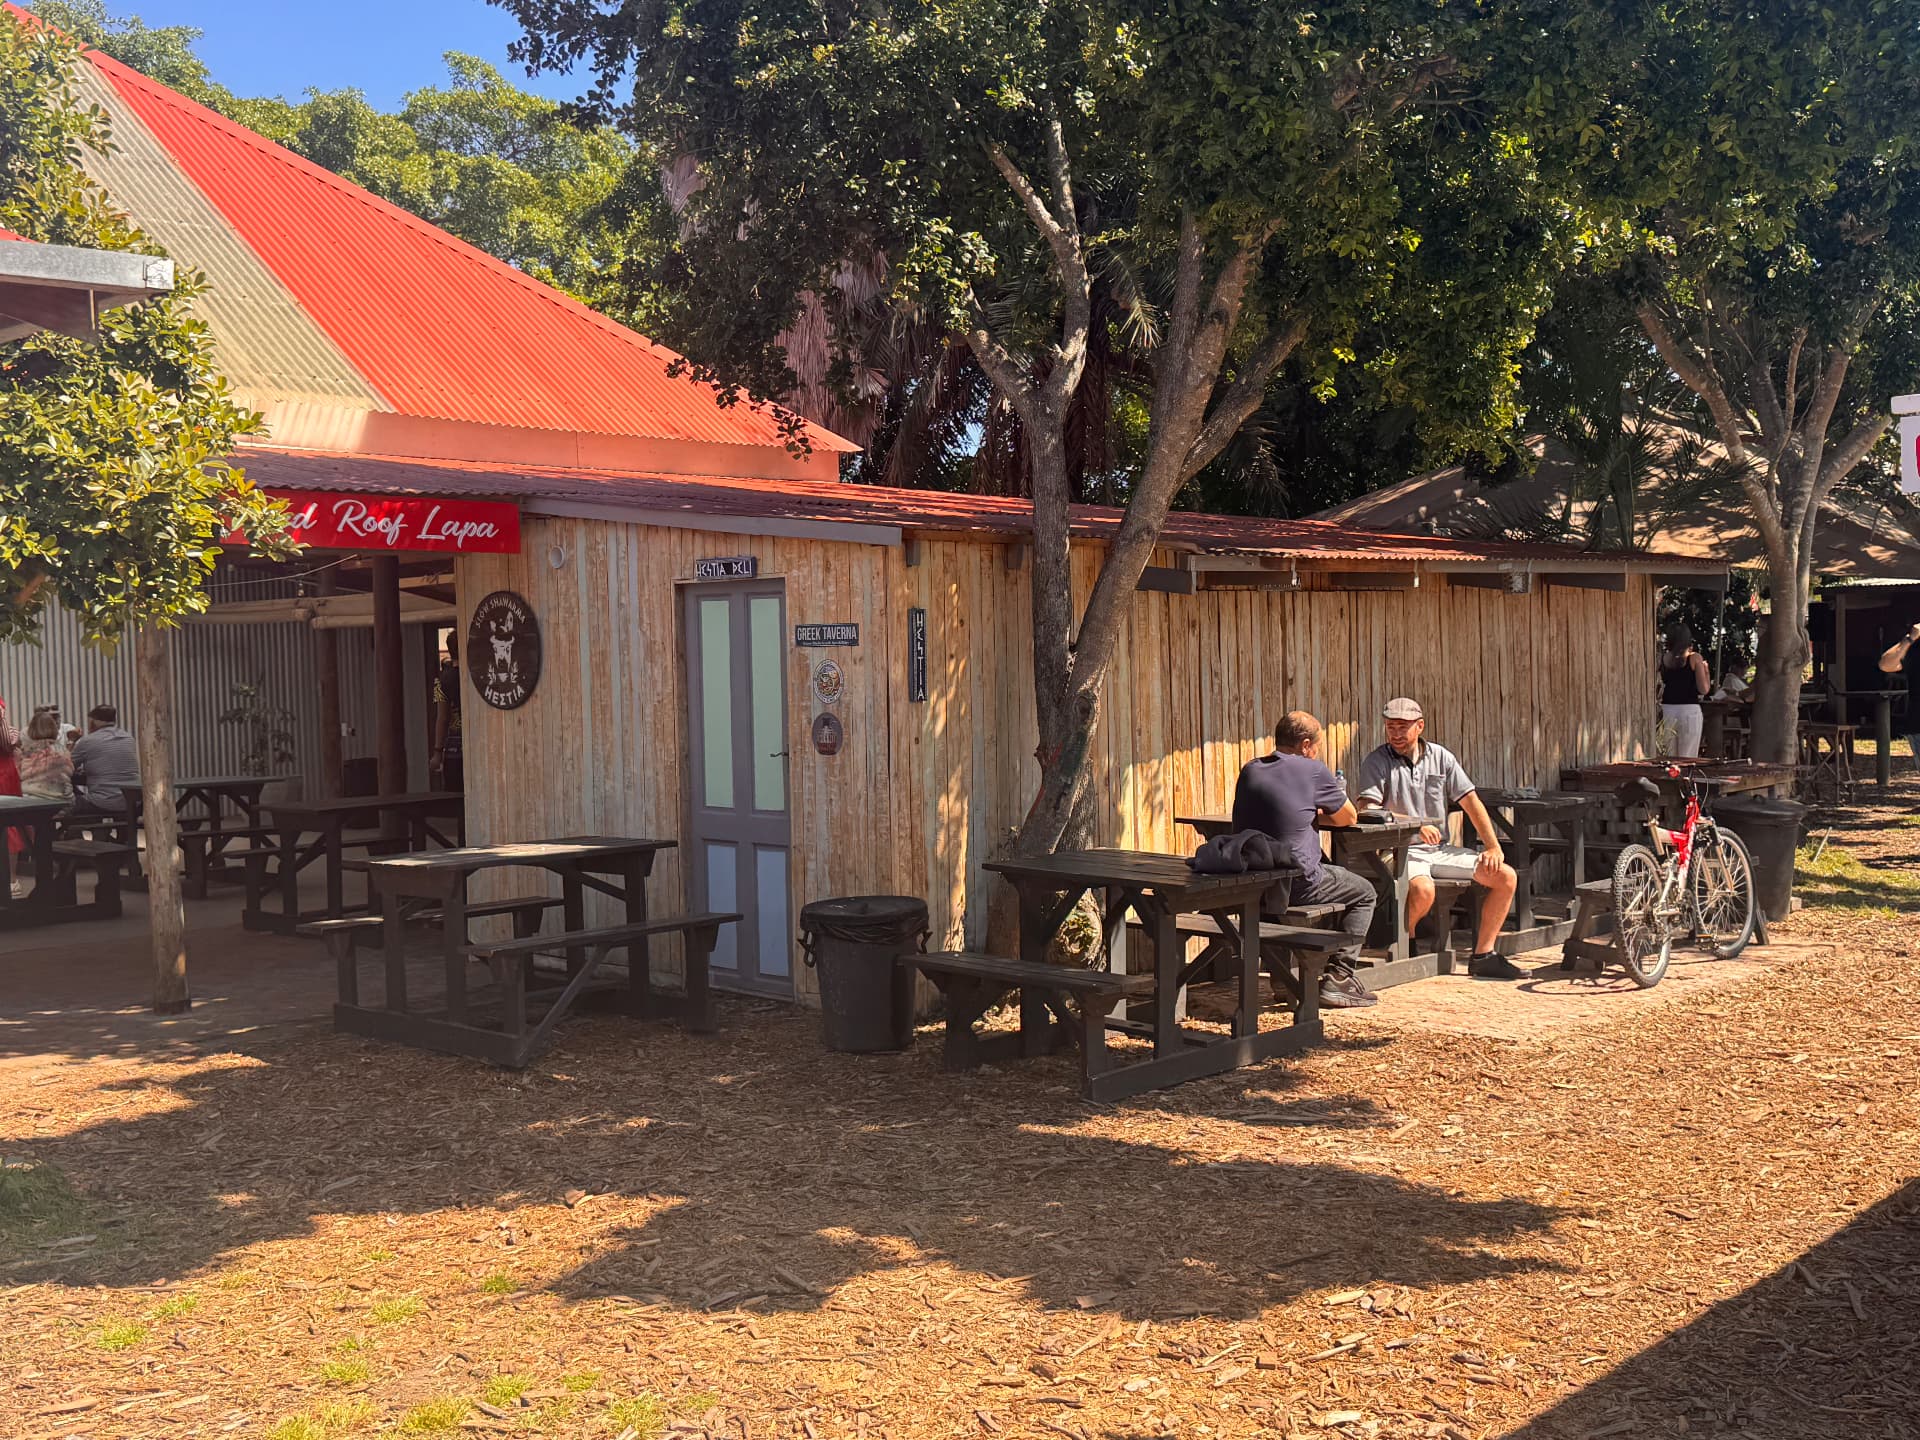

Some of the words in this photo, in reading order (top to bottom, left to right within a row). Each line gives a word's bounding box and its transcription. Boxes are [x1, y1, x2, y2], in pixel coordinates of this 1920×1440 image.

[333, 500, 408, 546] Roof
[416, 505, 499, 548] Lapa
[475, 603, 489, 629] SLOW
[489, 597, 526, 624] SHAWARMA
[797, 627, 821, 641] GREEK
[822, 626, 857, 640] TAVERNA
